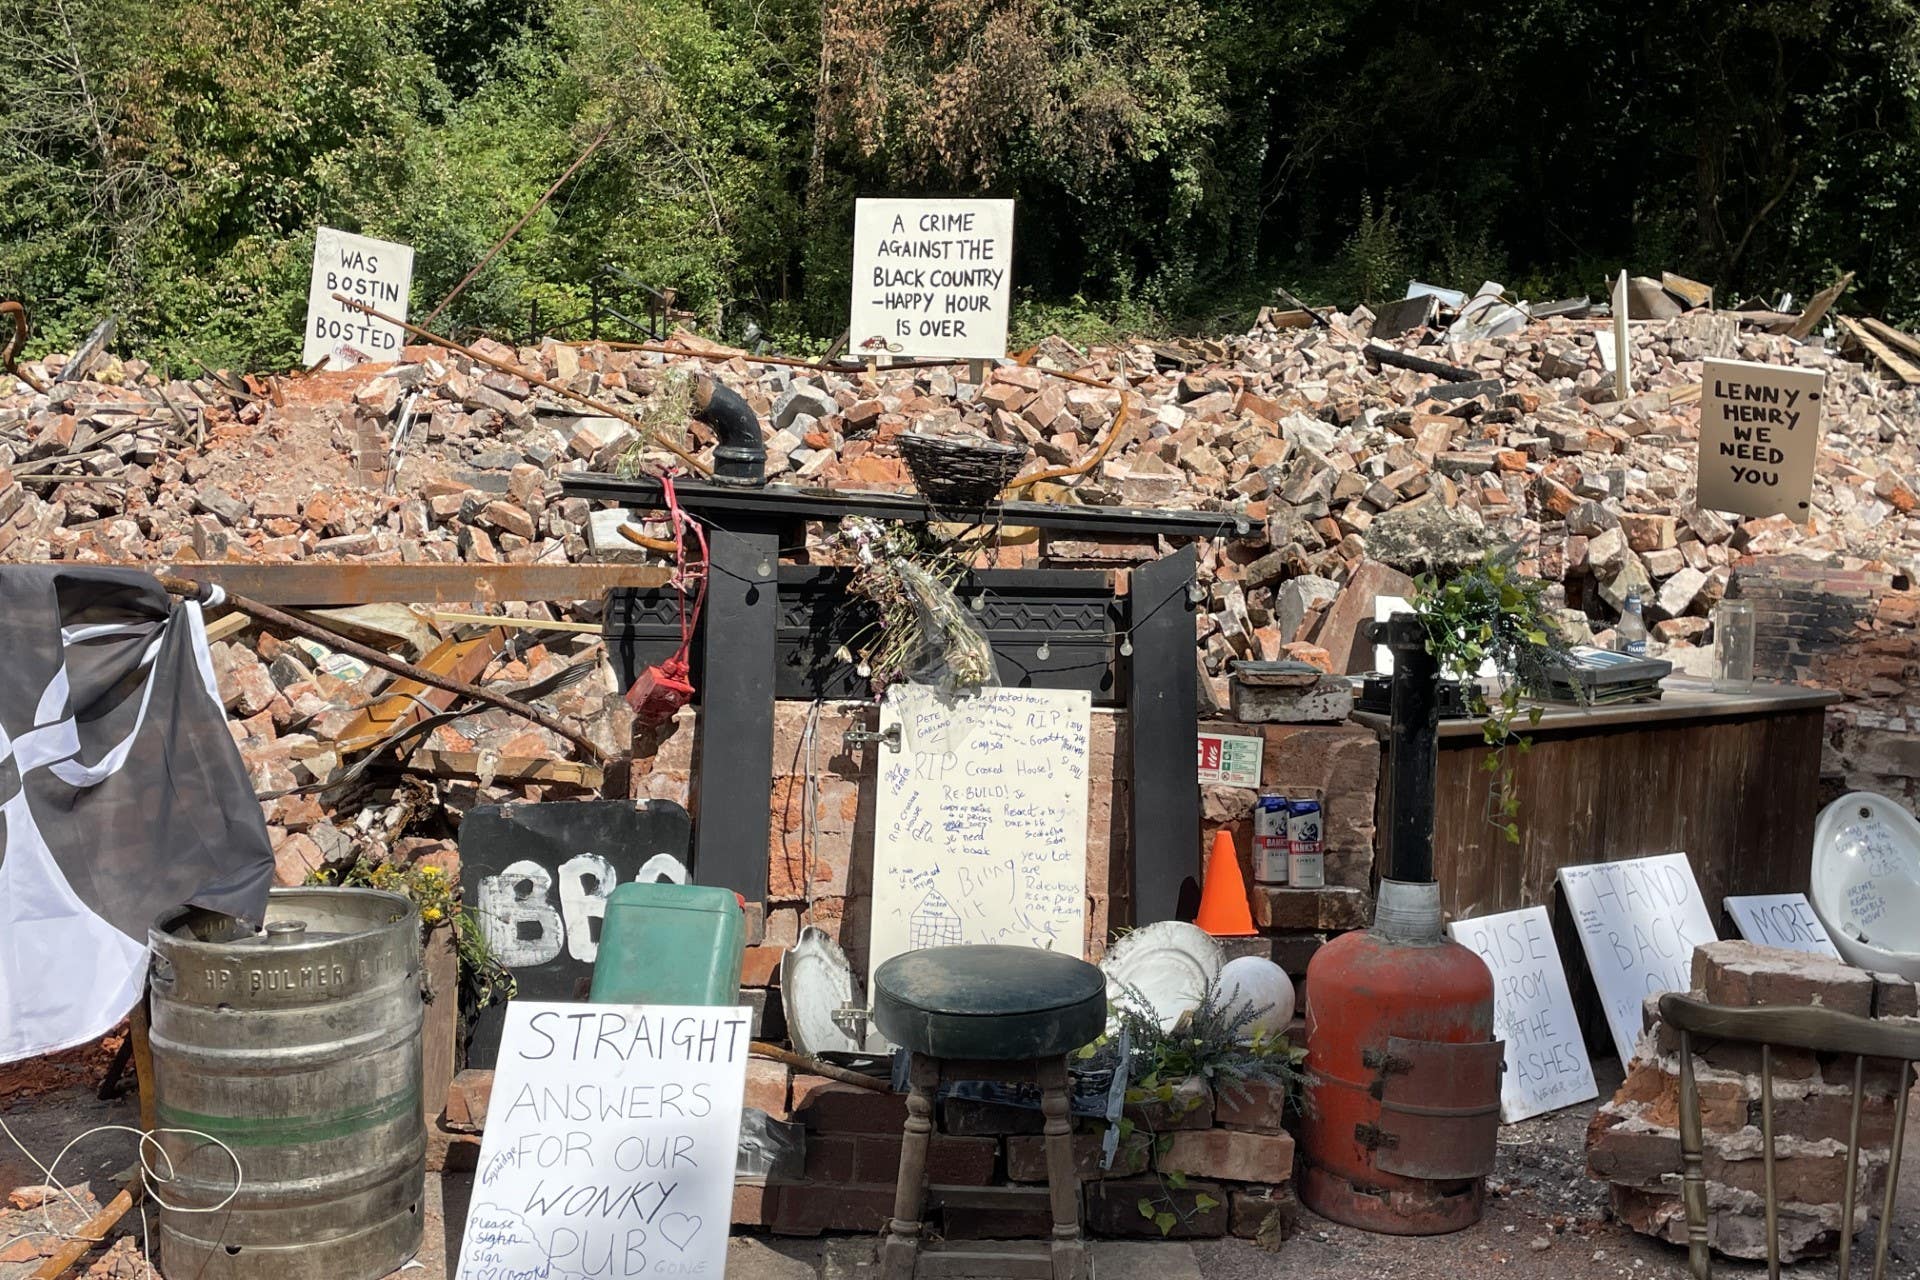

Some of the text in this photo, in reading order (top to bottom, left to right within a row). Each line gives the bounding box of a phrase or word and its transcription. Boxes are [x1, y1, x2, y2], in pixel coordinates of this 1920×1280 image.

[892, 213, 975, 234] A CRIME
[341, 248, 378, 274] WAS
[877, 239, 994, 260] AGAINST THE
[327, 272, 399, 302] BOSTIN
[874, 266, 1004, 290] BLACK COUNTRY
[945, 294, 991, 314] HOUR
[316, 317, 395, 350] BOSTED
[896, 318, 967, 337] IS OVER
[1715, 380, 1800, 408] LENNY
[1723, 404, 1800, 430] HENRY
[1734, 426, 1771, 443] WE
[1720, 442, 1784, 464] NEED
[1730, 465, 1778, 486] YOU
[1026, 710, 1060, 729] RIP
[915, 751, 958, 780] RIP
[1589, 864, 1689, 915] HAND
[1750, 902, 1826, 945] MORE
[1474, 918, 1546, 968] RISE
[1608, 914, 1695, 971] BACK
[251, 963, 345, 993] BULMER
[1501, 969, 1552, 1008] FROM
[518, 1011, 746, 1063] STRAIGHT
[1513, 1008, 1556, 1048] THE
[1518, 1042, 1582, 1088] ASHES
[505, 1083, 712, 1123] ANSWERS
[516, 1131, 698, 1172] FOR OUR
[524, 1180, 678, 1225] WONKY
[547, 1227, 647, 1278] PUB
[653, 1260, 708, 1277] GONE
